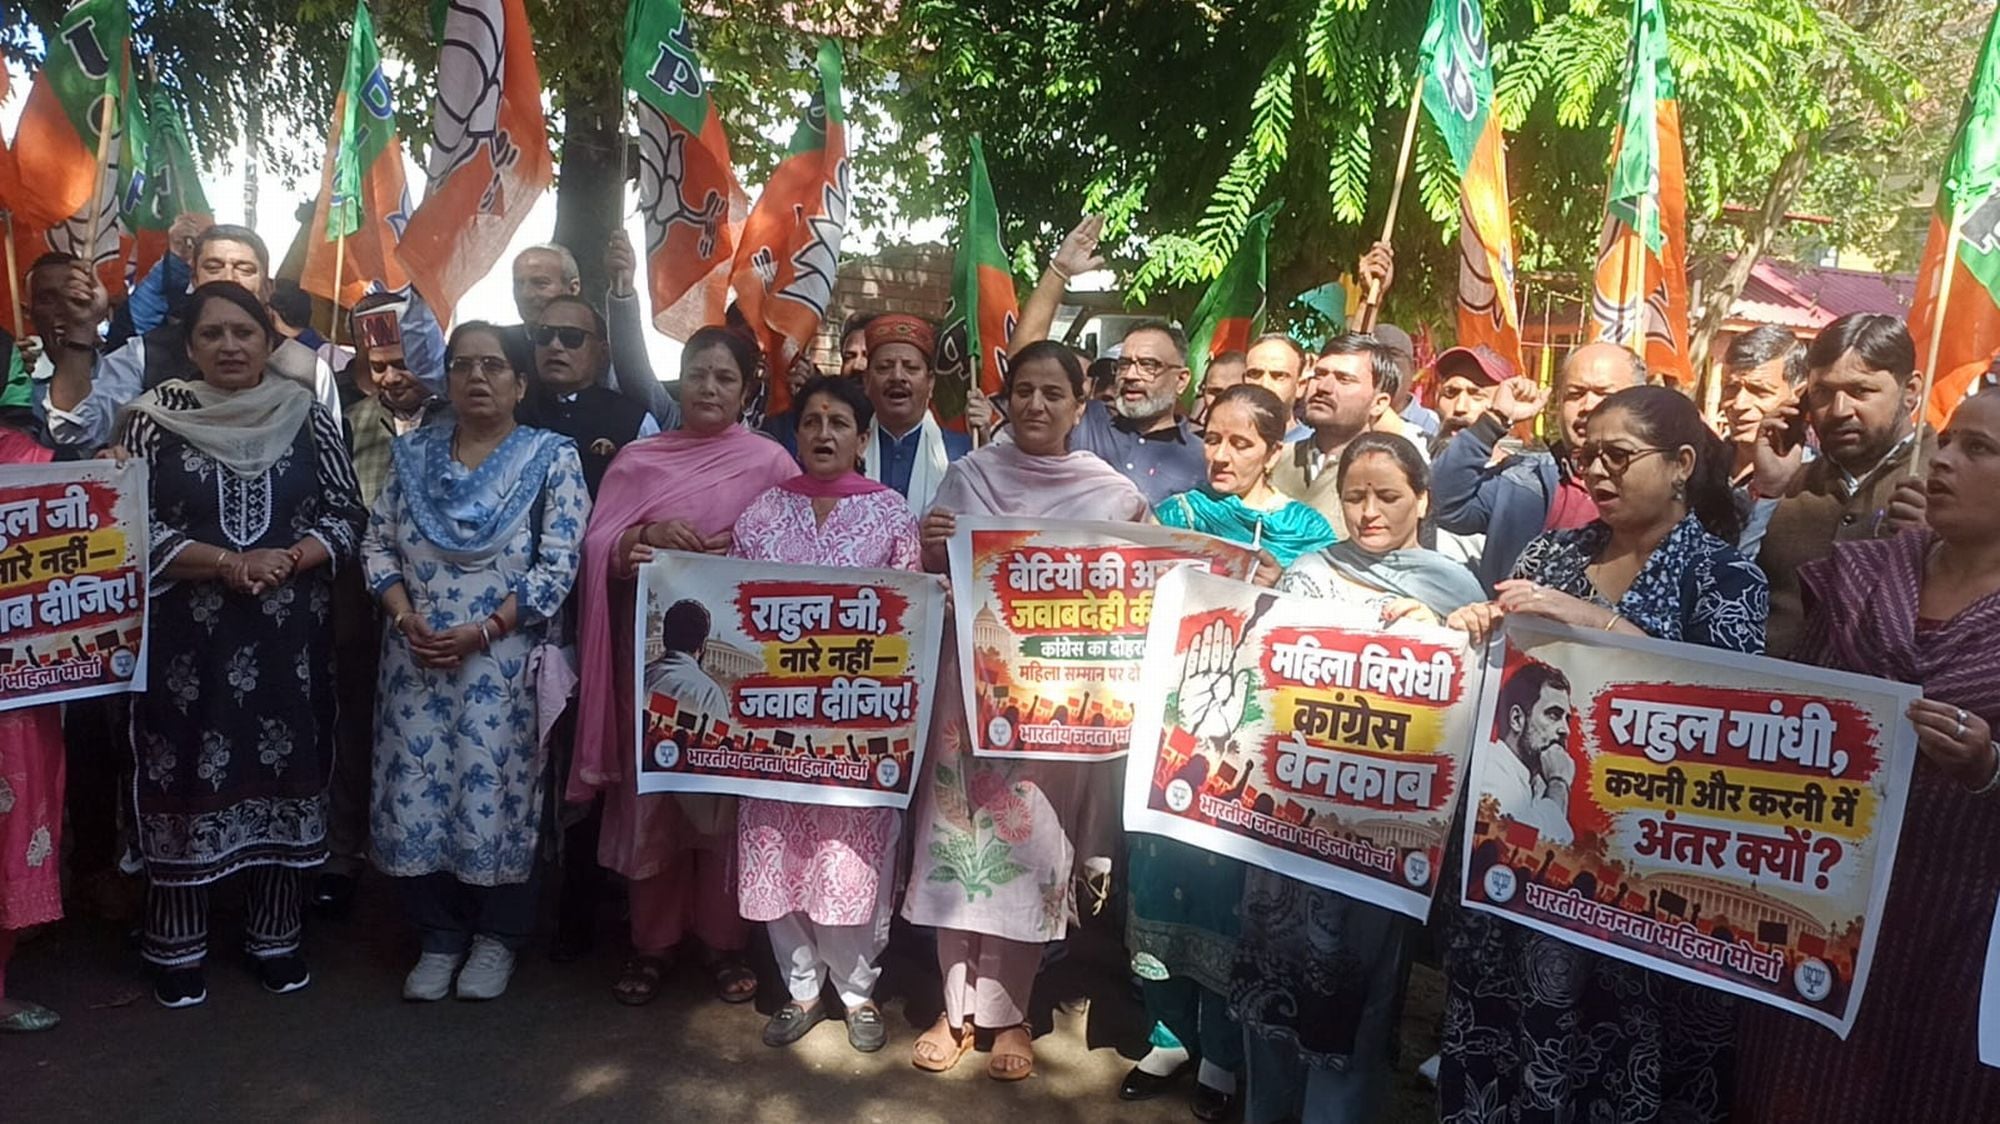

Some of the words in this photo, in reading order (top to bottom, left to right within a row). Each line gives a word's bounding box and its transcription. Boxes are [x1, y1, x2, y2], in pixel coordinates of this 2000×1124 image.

[46, 485, 99, 530] जी,
[1008, 553, 1083, 591] बेटियों
[1087, 552, 1125, 587] की
[0, 594, 33, 633] ाब
[37, 572, 139, 627] दीजिए!
[751, 595, 834, 642] राहुल
[838, 587, 887, 635] जी,
[1012, 589, 1126, 632] जवाबदेही
[780, 638, 822, 673] नारे
[1020, 661, 1060, 682] महिला
[1065, 666, 1105, 681] सम्मान
[1108, 667, 1124, 681] पर
[1041, 636, 1084, 657] कांग्रेस
[1087, 640, 1107, 657] का
[1110, 636, 1145, 658] दोहर
[1271, 635, 1357, 687] महिला
[1359, 644, 1456, 701] विरोधी
[4, 666, 60, 689] महिला
[62, 656, 101, 680] मोर्चा
[739, 686, 817, 719] जवाब
[821, 676, 912, 722] दीजिए!
[1294, 692, 1411, 751] कांग्रेस
[1019, 720, 1071, 744] भारतीय
[1071, 726, 1113, 746] जनता
[1609, 698, 1724, 762] राहुल
[1727, 699, 1848, 776] गांधी,
[687, 745, 740, 769] भारतीय
[741, 753, 783, 772] जनता
[785, 753, 832, 778] महिला
[832, 756, 869, 781] मोर्चा
[1276, 730, 1438, 808] बेनकाब
[1605, 766, 1688, 805] कथनी
[1691, 770, 1744, 813] और
[1748, 783, 1827, 823] करनी
[1831, 787, 1860, 827] में
[1199, 794, 1254, 829] भारतीय
[1254, 812, 1298, 843] जनता
[1299, 827, 1351, 859] महिला
[1352, 839, 1396, 872] मोर्चा
[1634, 809, 1731, 869] अंतर
[1736, 826, 1843, 890] क्यों?
[1526, 882, 1599, 925] भारतीय
[1598, 904, 1658, 942] जनता
[1656, 922, 1728, 959] महिला
[1728, 940, 1783, 983] मोर्चा
